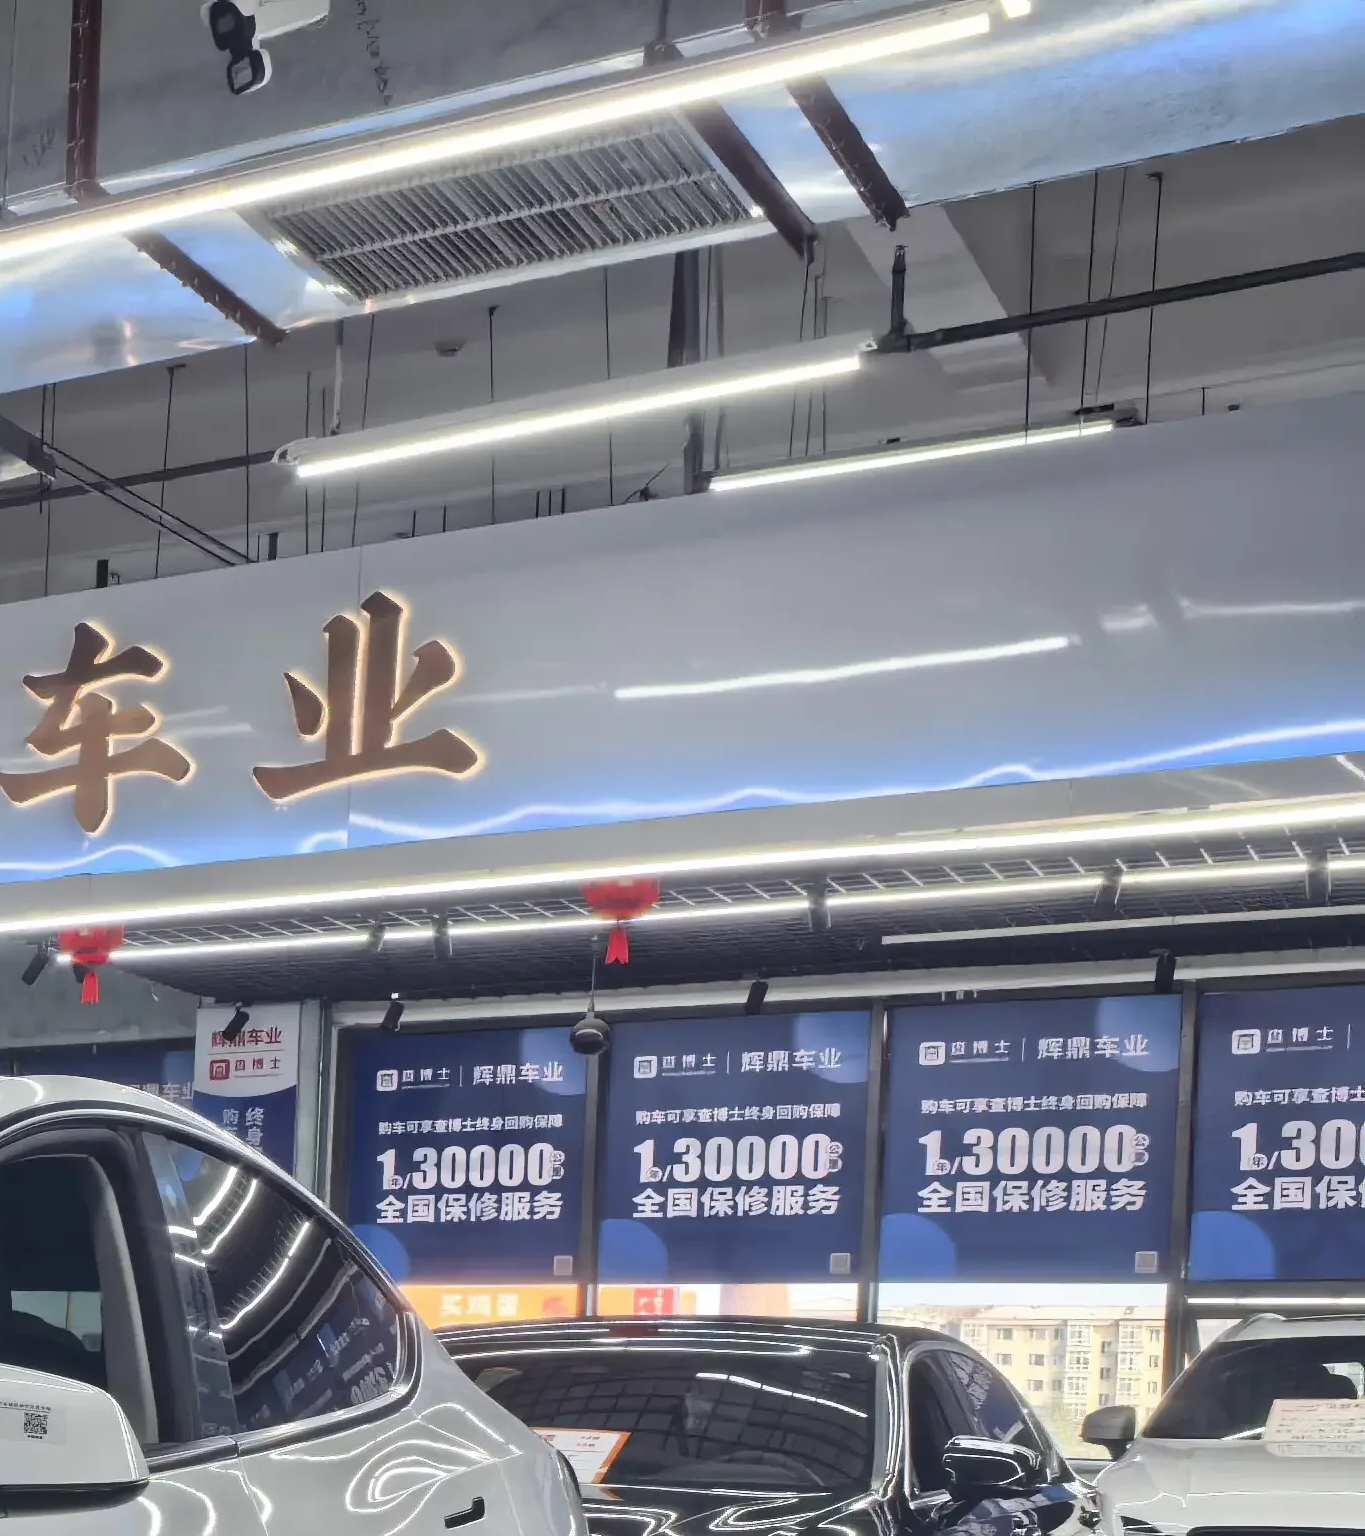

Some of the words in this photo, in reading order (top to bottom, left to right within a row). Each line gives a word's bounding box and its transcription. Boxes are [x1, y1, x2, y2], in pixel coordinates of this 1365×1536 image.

[1037, 1033, 1150, 1060] 辉鼎车业
[741, 1047, 842, 1073] 辉鼎车业
[473, 1061, 564, 1086] 辉鼎车业
[920, 1092, 1149, 1115] 购车可享查博士终身回购保障
[1234, 1084, 1365, 1107] 购车可享查博士
[378, 1113, 564, 1135] 购车可享查博士终身回购保障
[635, 1103, 841, 1125] 购车可享查博士终身回购保障
[245, 1107, 266, 1153] 终身
[632, 1184, 842, 1218] 全国保修服务
[917, 1178, 1148, 1213] 全国保修服务
[1230, 1176, 1365, 1211] 全国保
[375, 1190, 564, 1224] 全国保修服务
